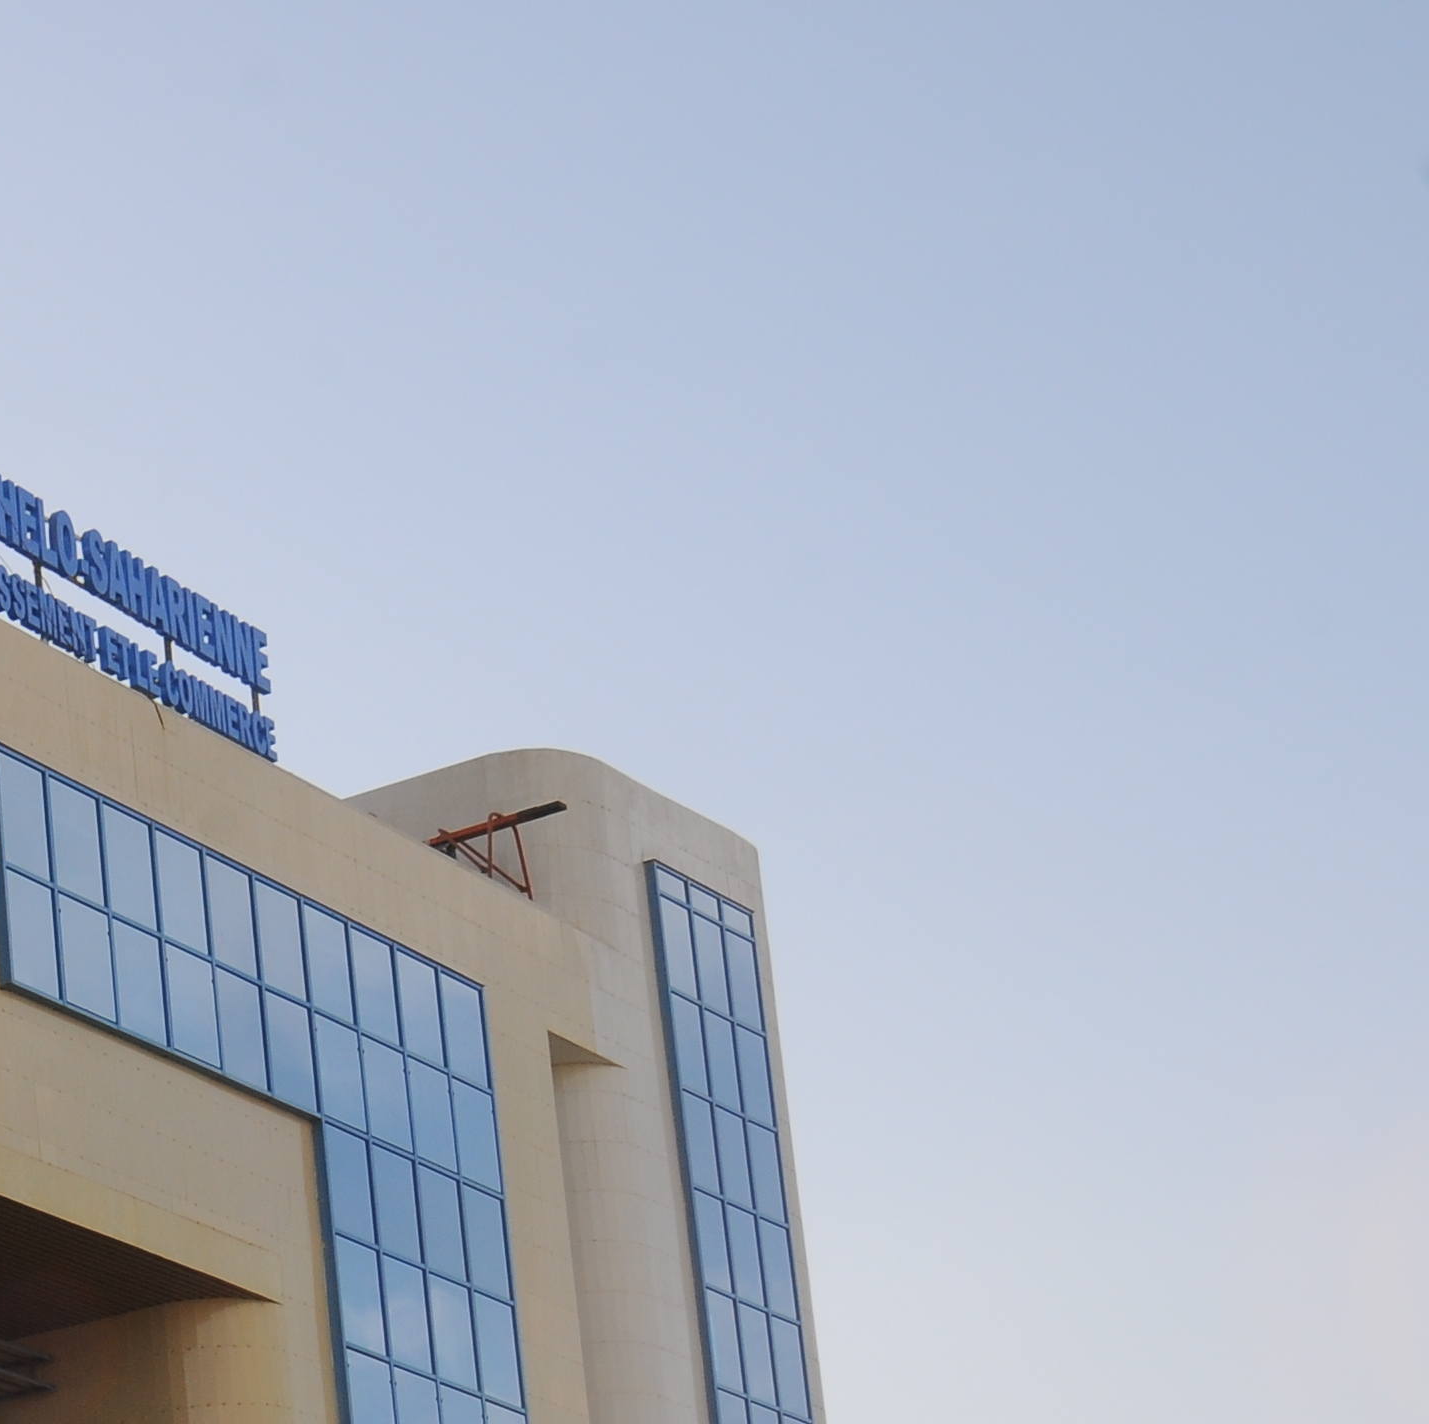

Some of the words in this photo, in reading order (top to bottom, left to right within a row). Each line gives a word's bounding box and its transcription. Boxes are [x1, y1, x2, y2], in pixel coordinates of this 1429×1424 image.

[98, 625, 131, 681] ET
[128, 643, 161, 698] LE
[158, 660, 277, 762] COMMERCE
